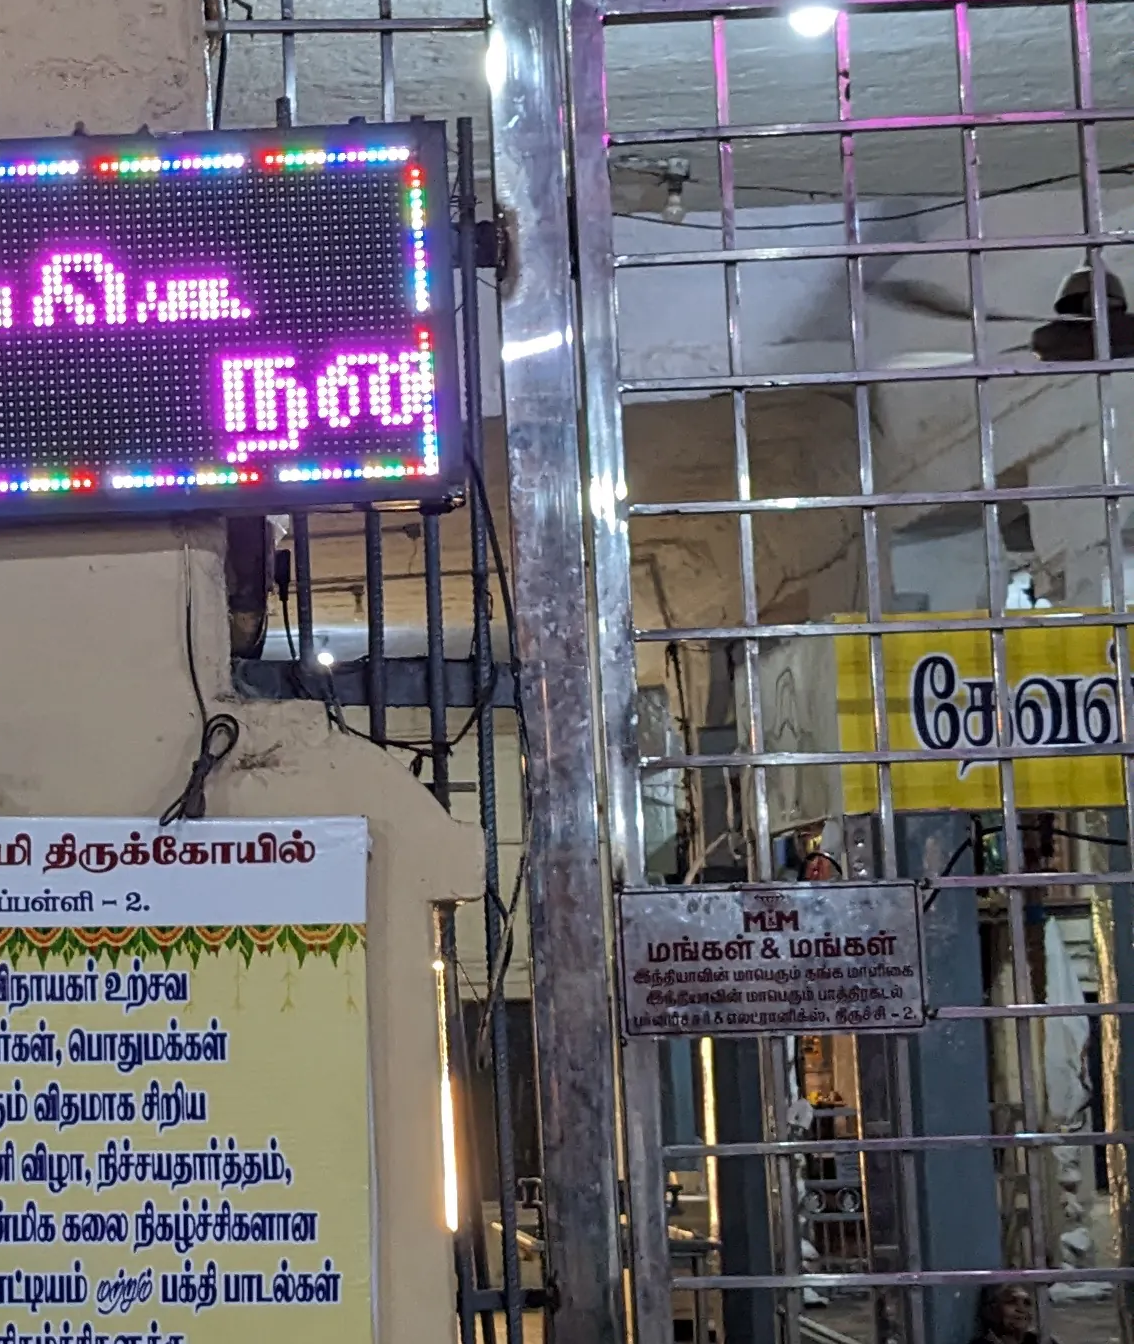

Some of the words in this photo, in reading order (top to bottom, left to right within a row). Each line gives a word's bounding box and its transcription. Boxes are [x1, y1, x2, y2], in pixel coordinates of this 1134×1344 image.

[43, 832, 316, 872] திருக்கோயில்
[127, 892, 151, 914] 2.
[743, 909, 799, 933] M&M
[648, 933, 754, 962] மங்கள்
[760, 937, 780, 959] &
[790, 929, 897, 958] மங்கள்
[105, 963, 188, 1009] உற்சவ
[70, 1020, 228, 1069] பொதுமக்கள்
[35, 1083, 135, 1126] விதமாக
[143, 1081, 205, 1128] சிறிய
[22, 1140, 91, 1190] விழா,
[97, 1139, 292, 1190] நிச்சயதார்த்தம்,
[63, 1213, 127, 1241] கலை
[134, 1199, 317, 1252] நிகழ்ச்சிகளான
[161, 1263, 216, 1314] பக்தி
[224, 1259, 340, 1304] பாடல்கள்
